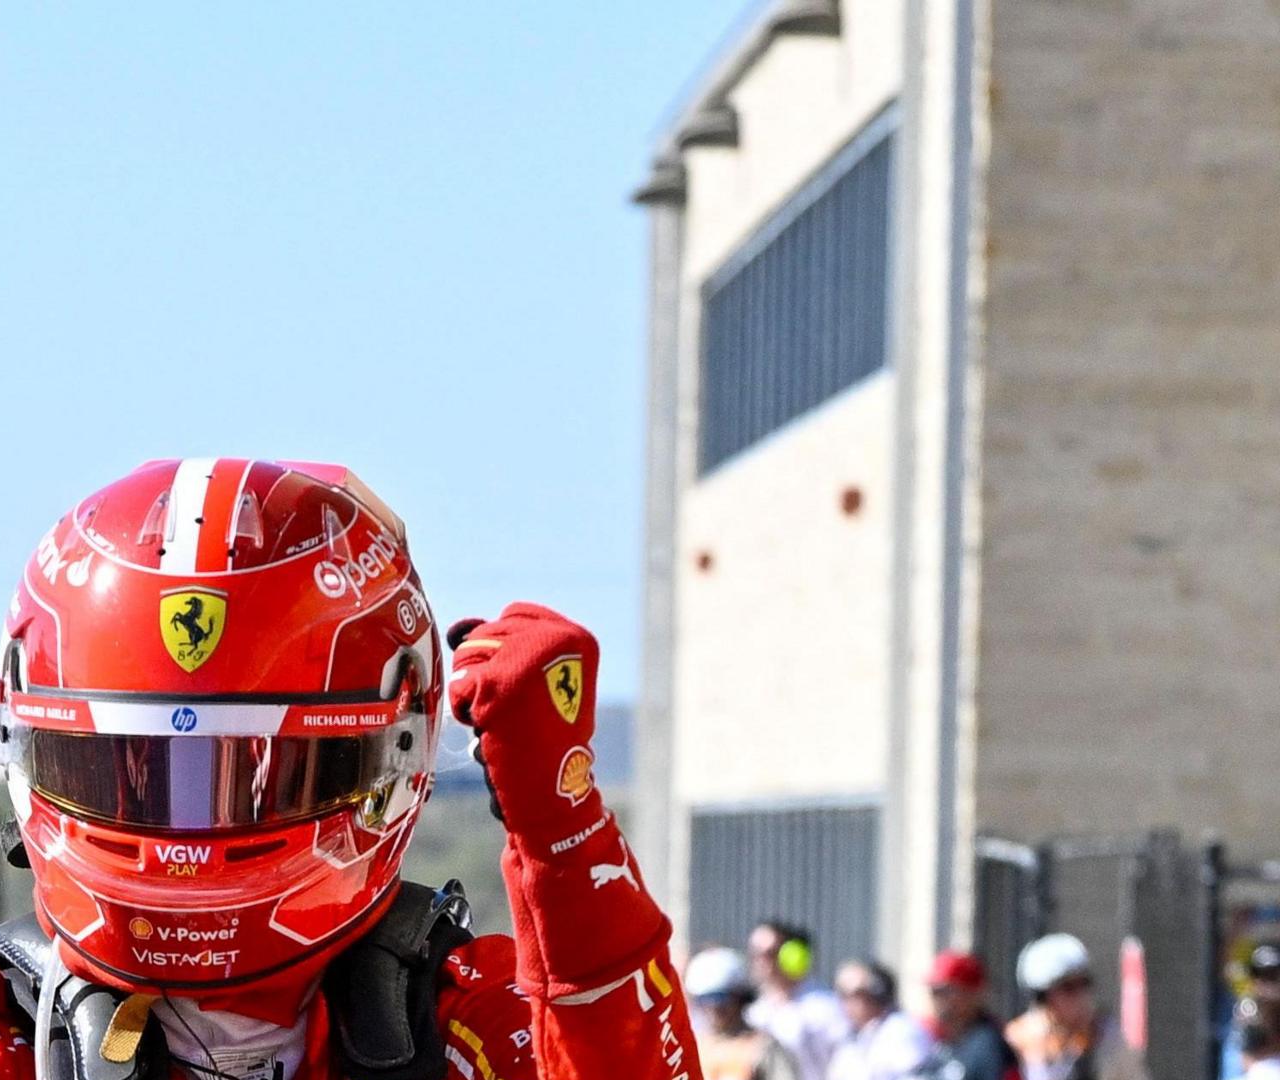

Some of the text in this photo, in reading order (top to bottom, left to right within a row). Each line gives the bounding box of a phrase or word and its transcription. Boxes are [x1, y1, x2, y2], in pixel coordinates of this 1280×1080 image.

[303, 714, 388, 727] RICHARD MILLE
[155, 844, 211, 864] VGW
[167, 864, 198, 876] PLAY
[157, 926, 238, 942] V-Power
